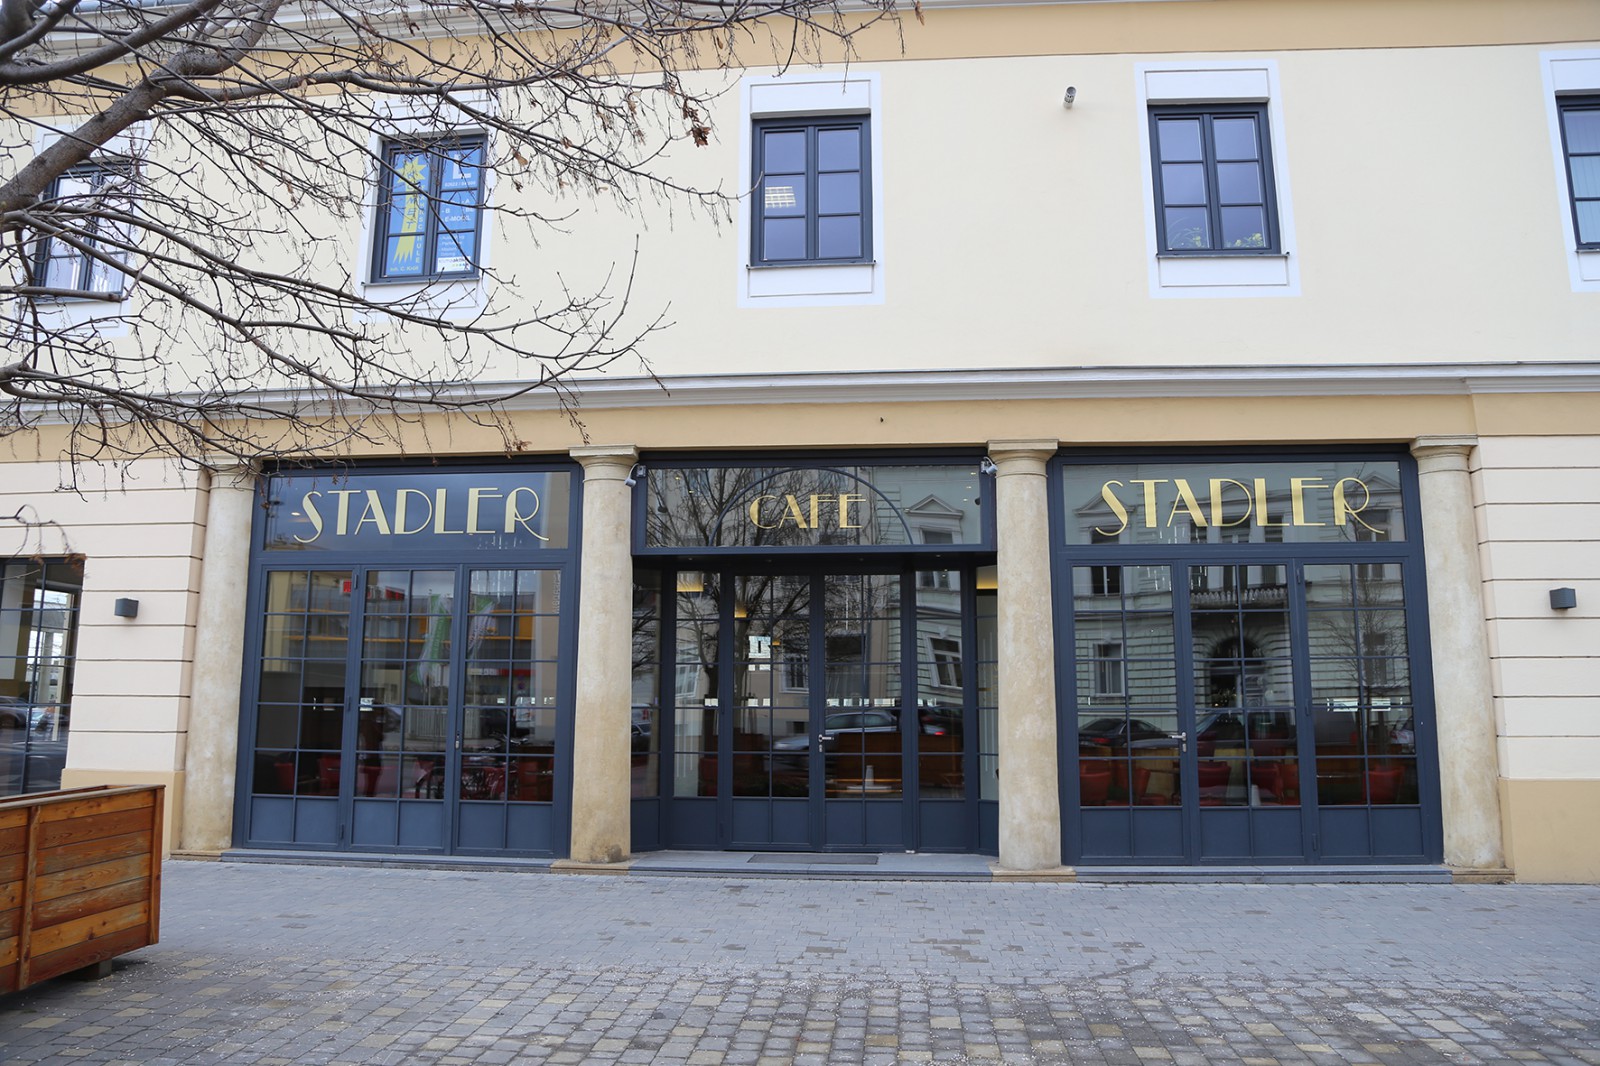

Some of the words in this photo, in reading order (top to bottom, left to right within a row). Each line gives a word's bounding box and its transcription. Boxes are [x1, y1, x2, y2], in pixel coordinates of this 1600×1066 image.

[293, 487, 550, 543] STADLER
[750, 494, 866, 529] CAFE
[1094, 477, 1385, 536] STADLER
